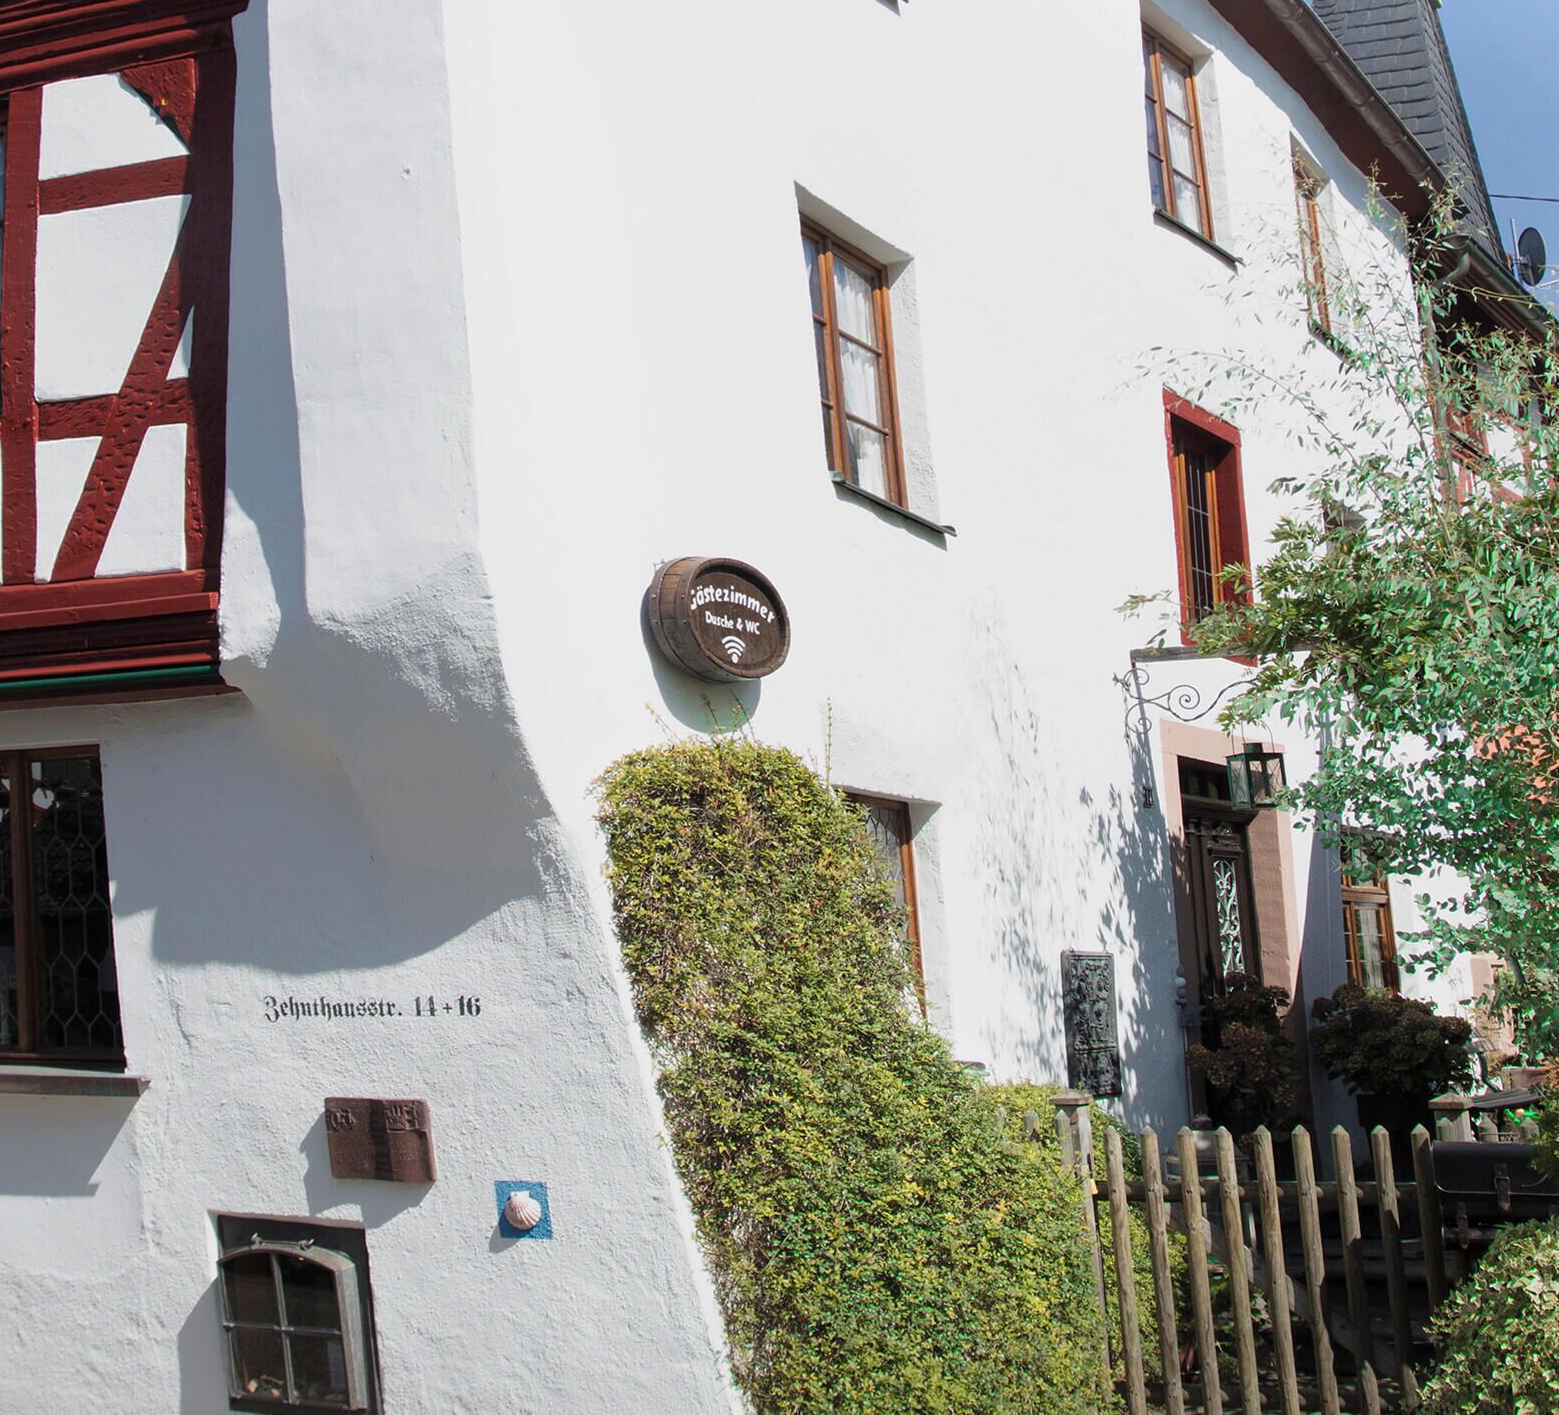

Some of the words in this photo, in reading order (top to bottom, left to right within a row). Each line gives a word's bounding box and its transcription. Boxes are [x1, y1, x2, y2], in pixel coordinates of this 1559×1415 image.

[705, 610, 734, 629] Dusche
[736, 617, 744, 632] &
[745, 619, 761, 635] WC
[263, 995, 403, 1023] Zehnthausstr.
